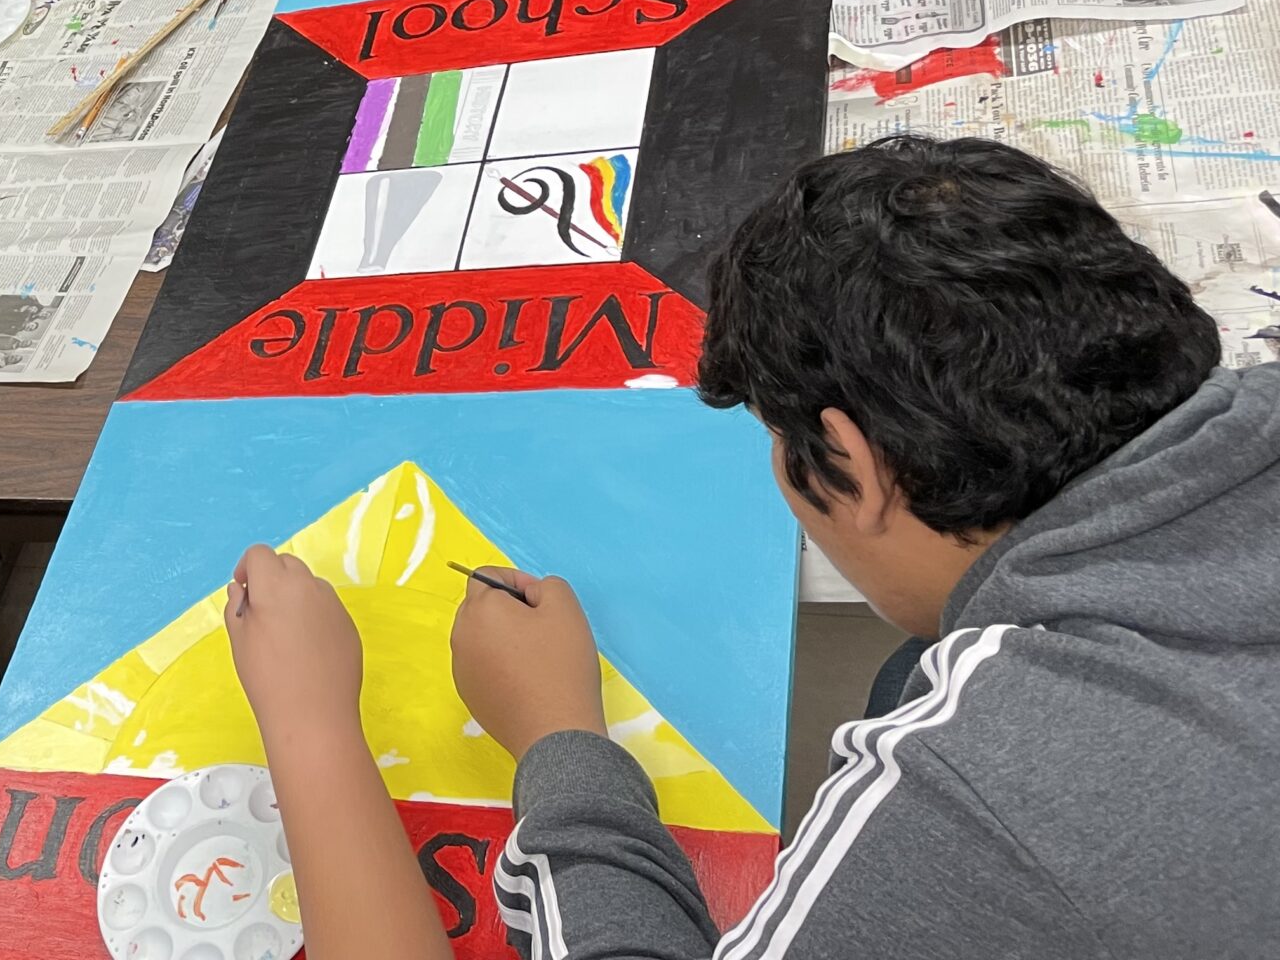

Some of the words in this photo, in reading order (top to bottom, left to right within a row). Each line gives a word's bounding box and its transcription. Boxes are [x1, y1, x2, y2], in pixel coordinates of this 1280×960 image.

[170, 70, 182, 86] spill
[990, 82, 1002, 101] Pack
[156, 95, 172, 115] North
[250, 291, 676, 381] Middle
